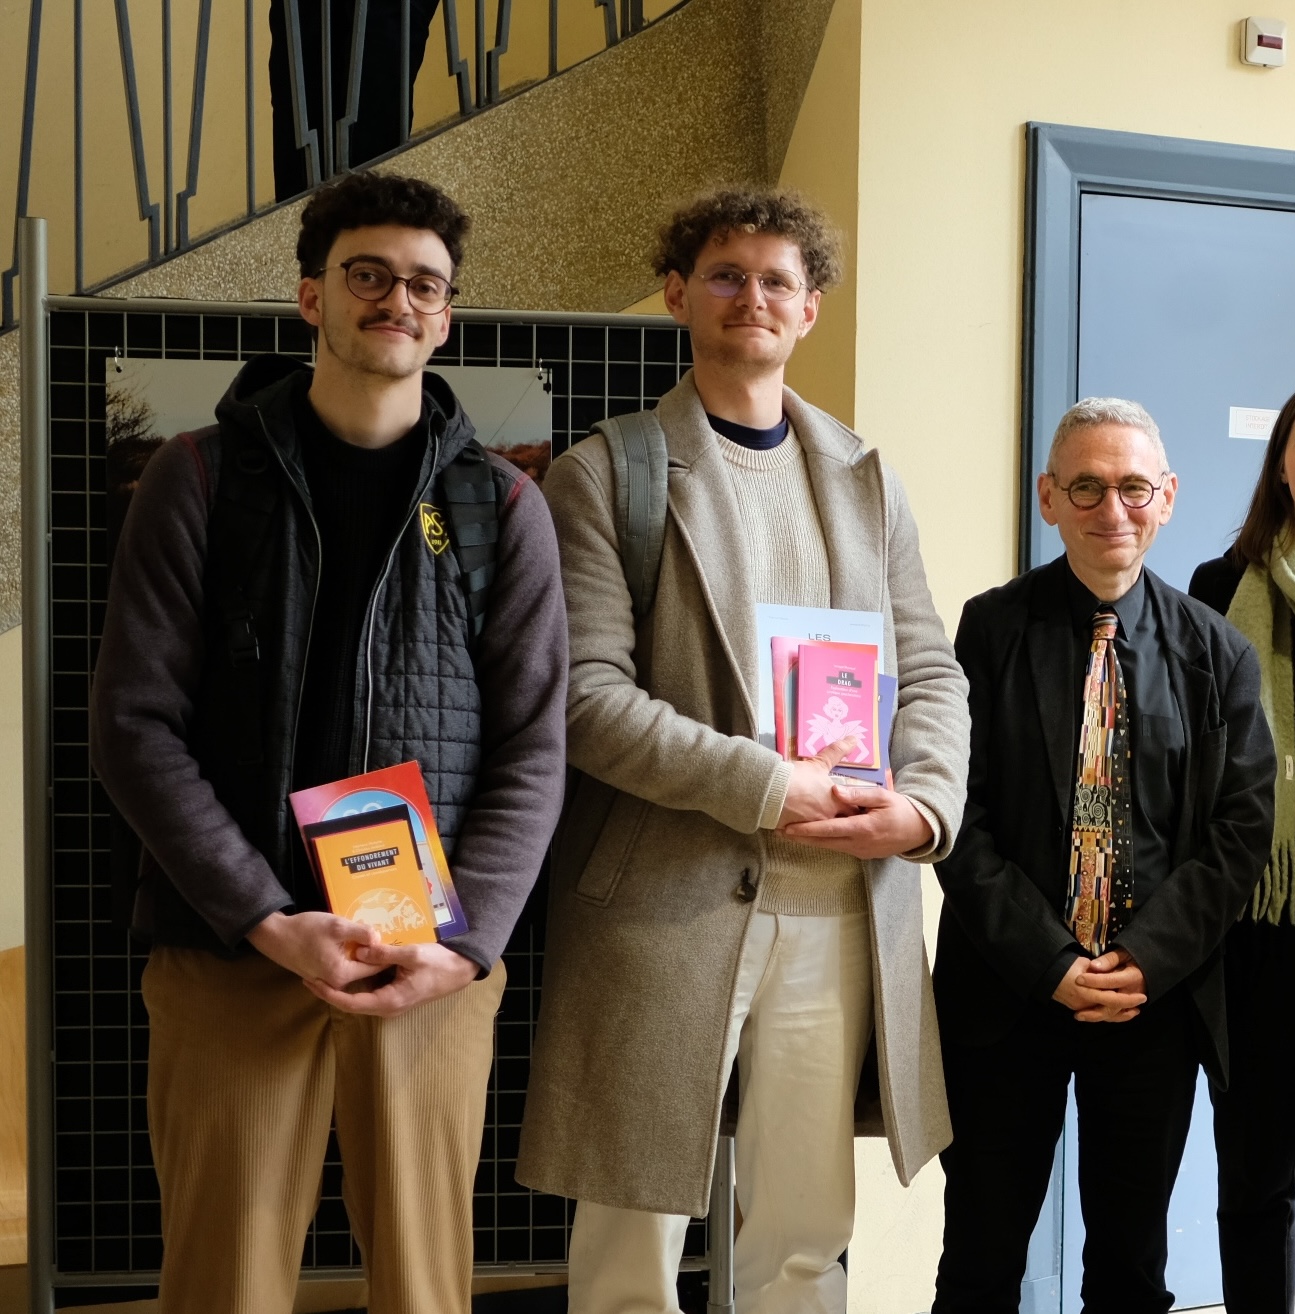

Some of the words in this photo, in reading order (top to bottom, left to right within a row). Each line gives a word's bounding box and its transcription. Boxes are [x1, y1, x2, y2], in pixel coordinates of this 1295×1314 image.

[808, 632, 831, 642] LES
[344, 849, 397, 865] L'EFFONDREMENT
[356, 863, 366, 871] DU
[367, 858, 390, 869] VIVANT
